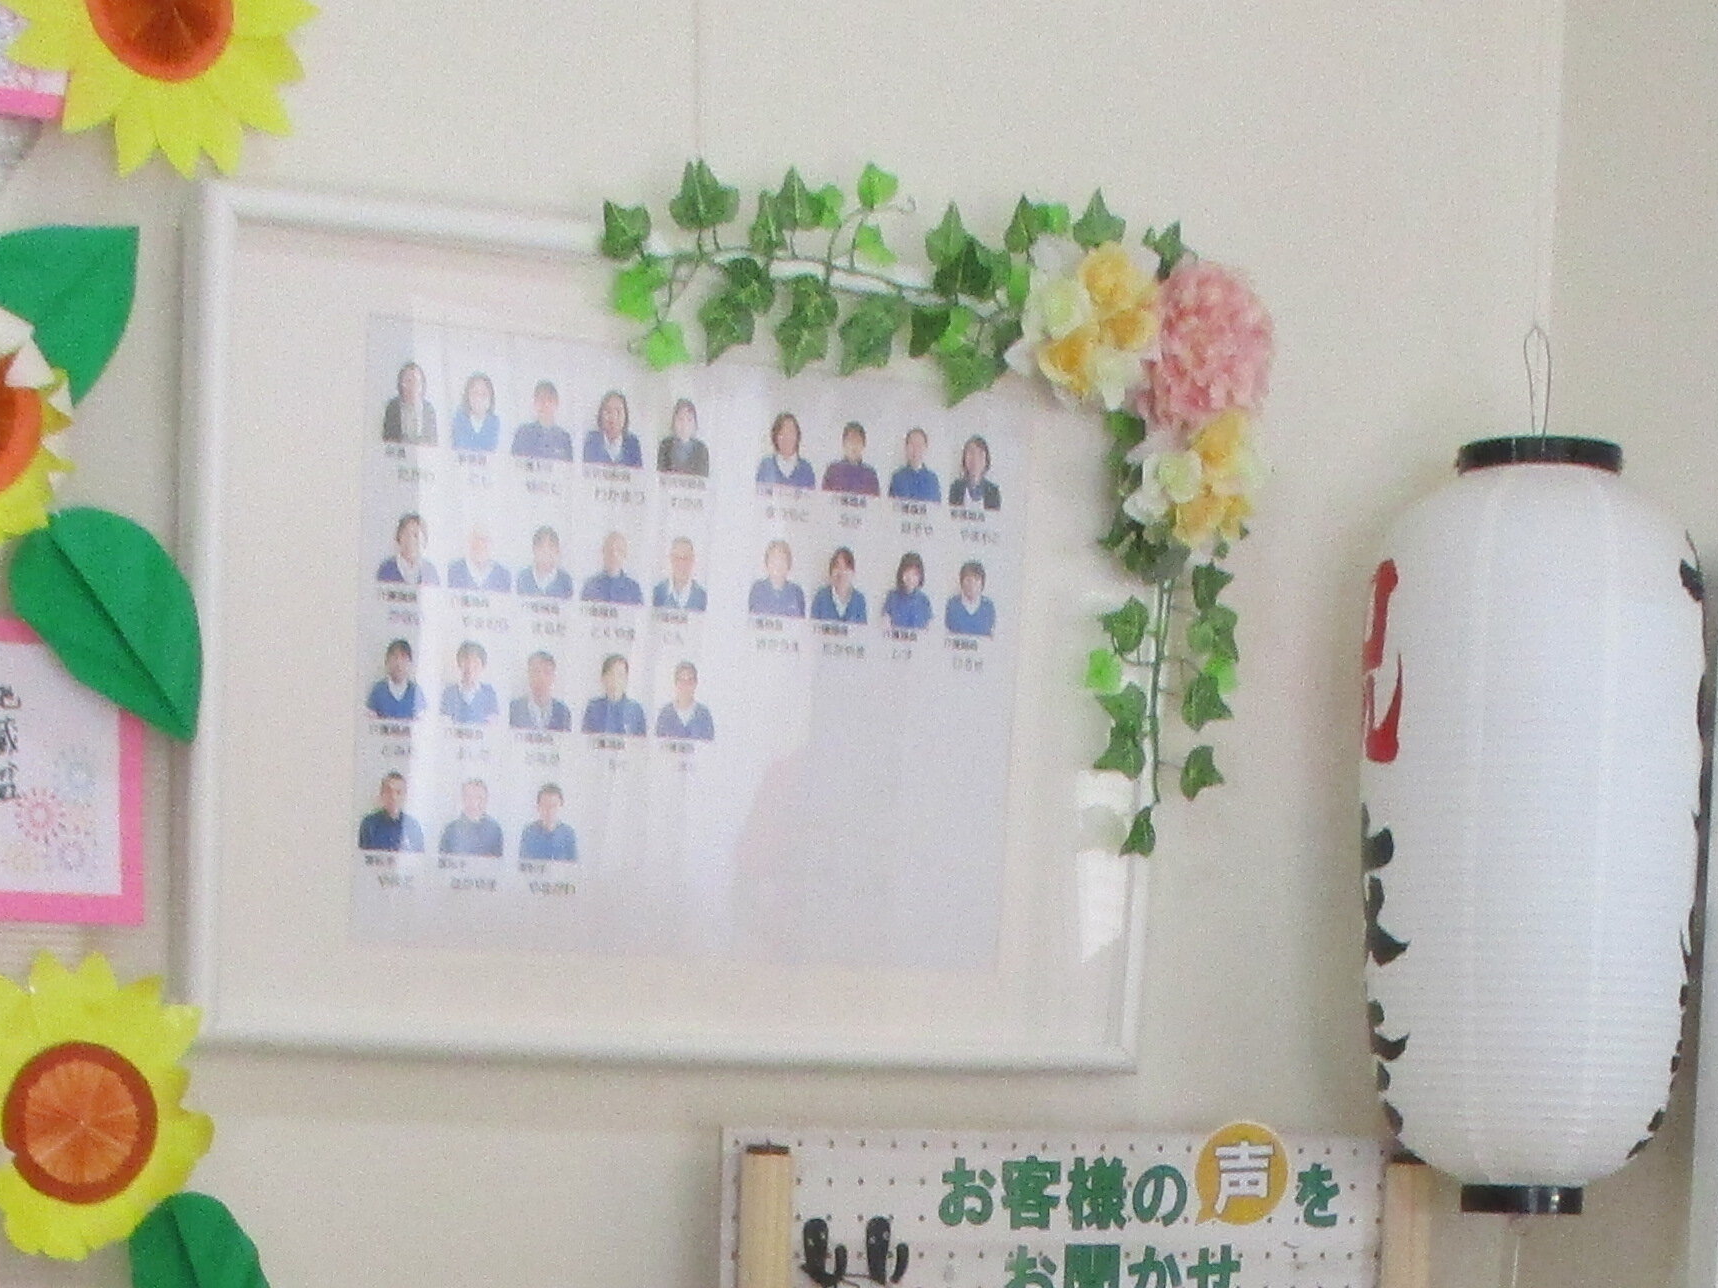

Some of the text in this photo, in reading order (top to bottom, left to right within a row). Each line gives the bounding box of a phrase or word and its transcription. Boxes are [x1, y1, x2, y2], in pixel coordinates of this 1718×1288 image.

[937, 1140, 1341, 1229] お客様の声を
